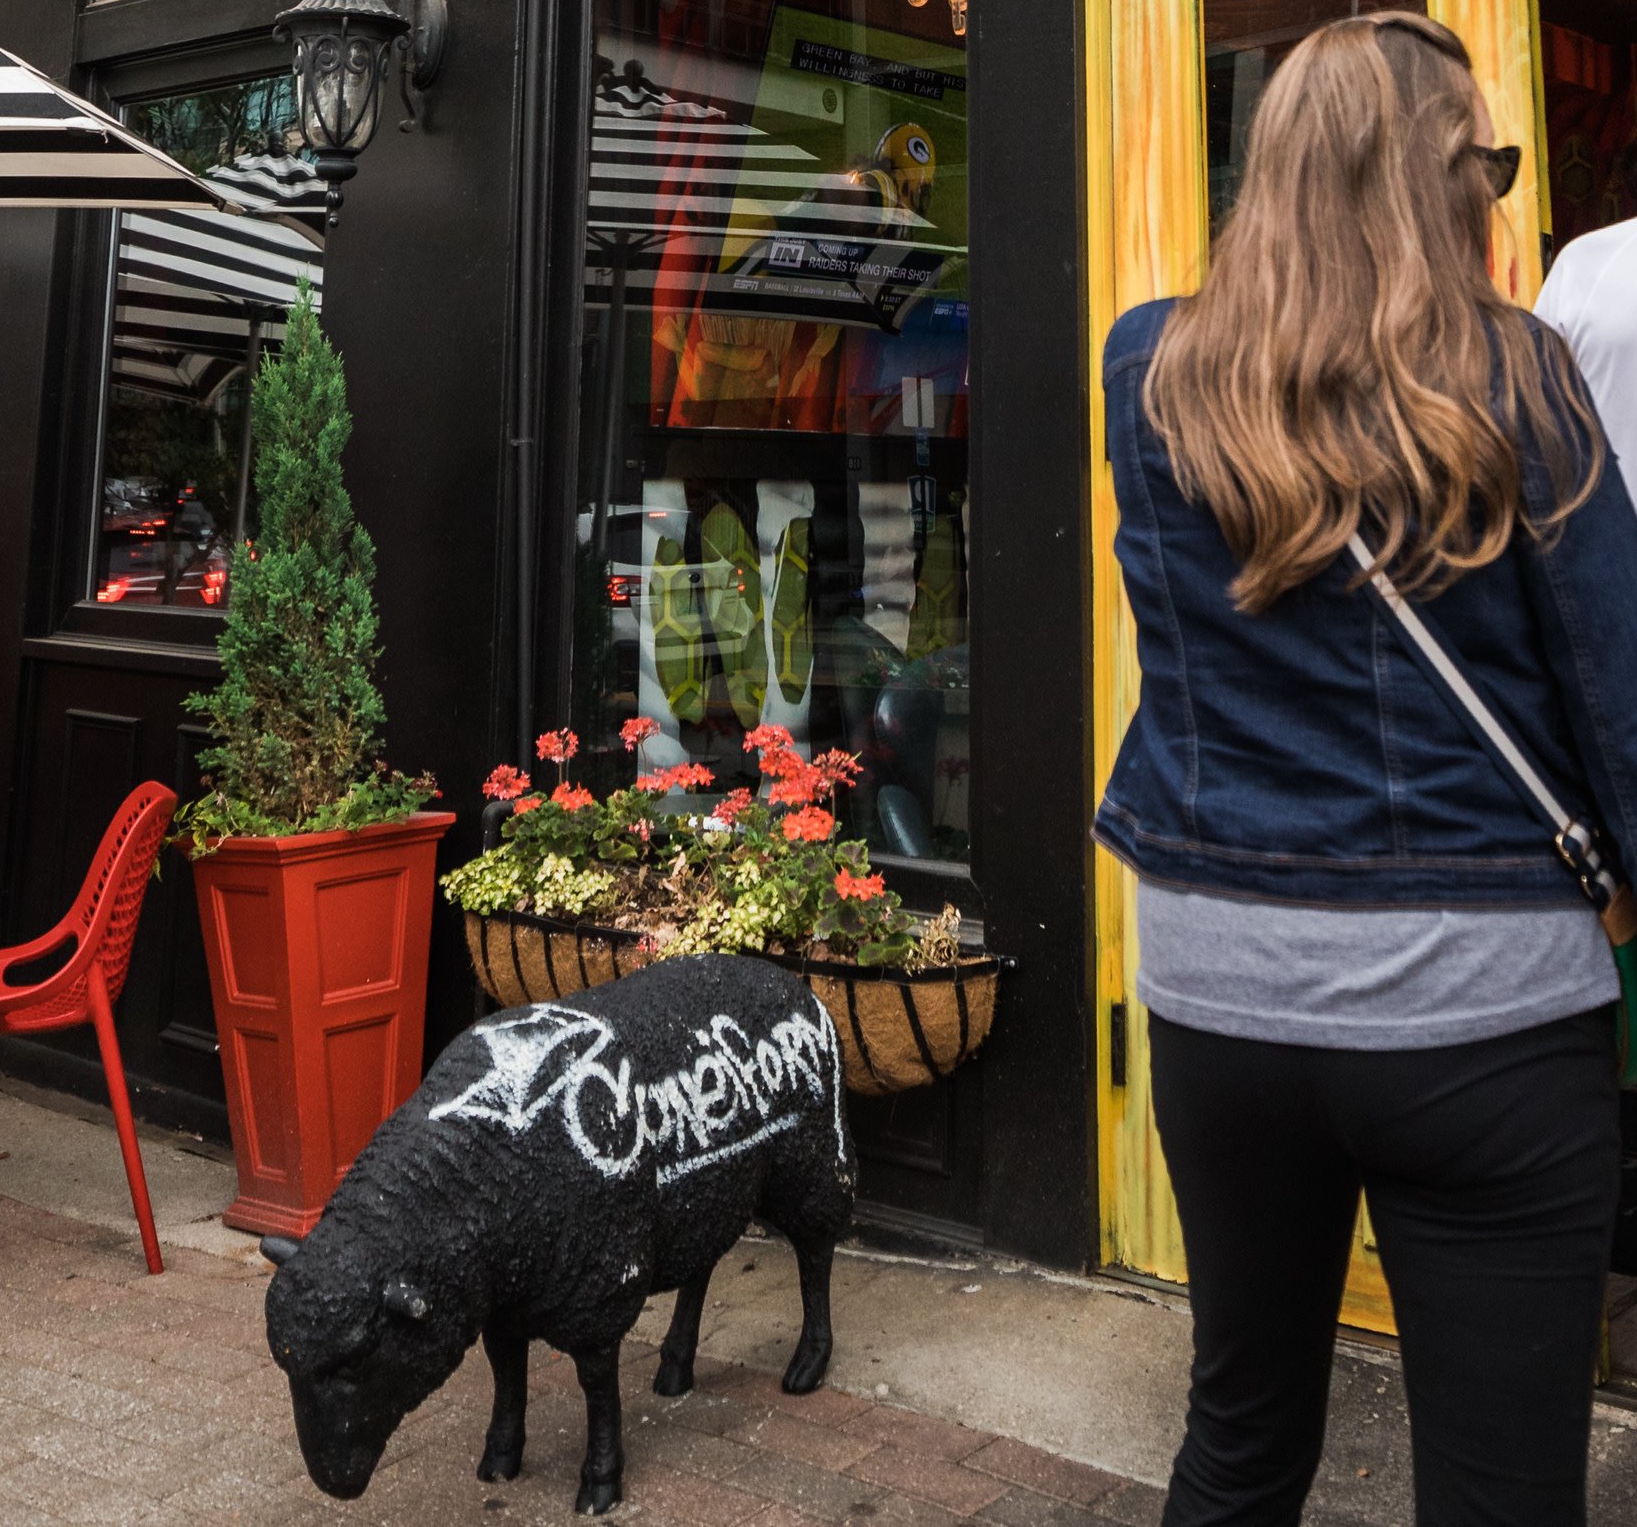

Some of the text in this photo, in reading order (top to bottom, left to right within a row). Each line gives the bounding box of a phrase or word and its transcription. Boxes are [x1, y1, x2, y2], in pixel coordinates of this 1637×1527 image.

[799, 57, 942, 99] WILLINGNESS TO TAKE
[802, 42, 843, 61] GREEN
[886, 63, 909, 75] AND
[915, 68, 935, 81] BUT
[943, 75, 966, 89] HIS
[772, 245, 802, 264] IN
[818, 244, 859, 256] COMING UP
[808, 257, 931, 282] RAIDERS TAKING THEIR SHOT
